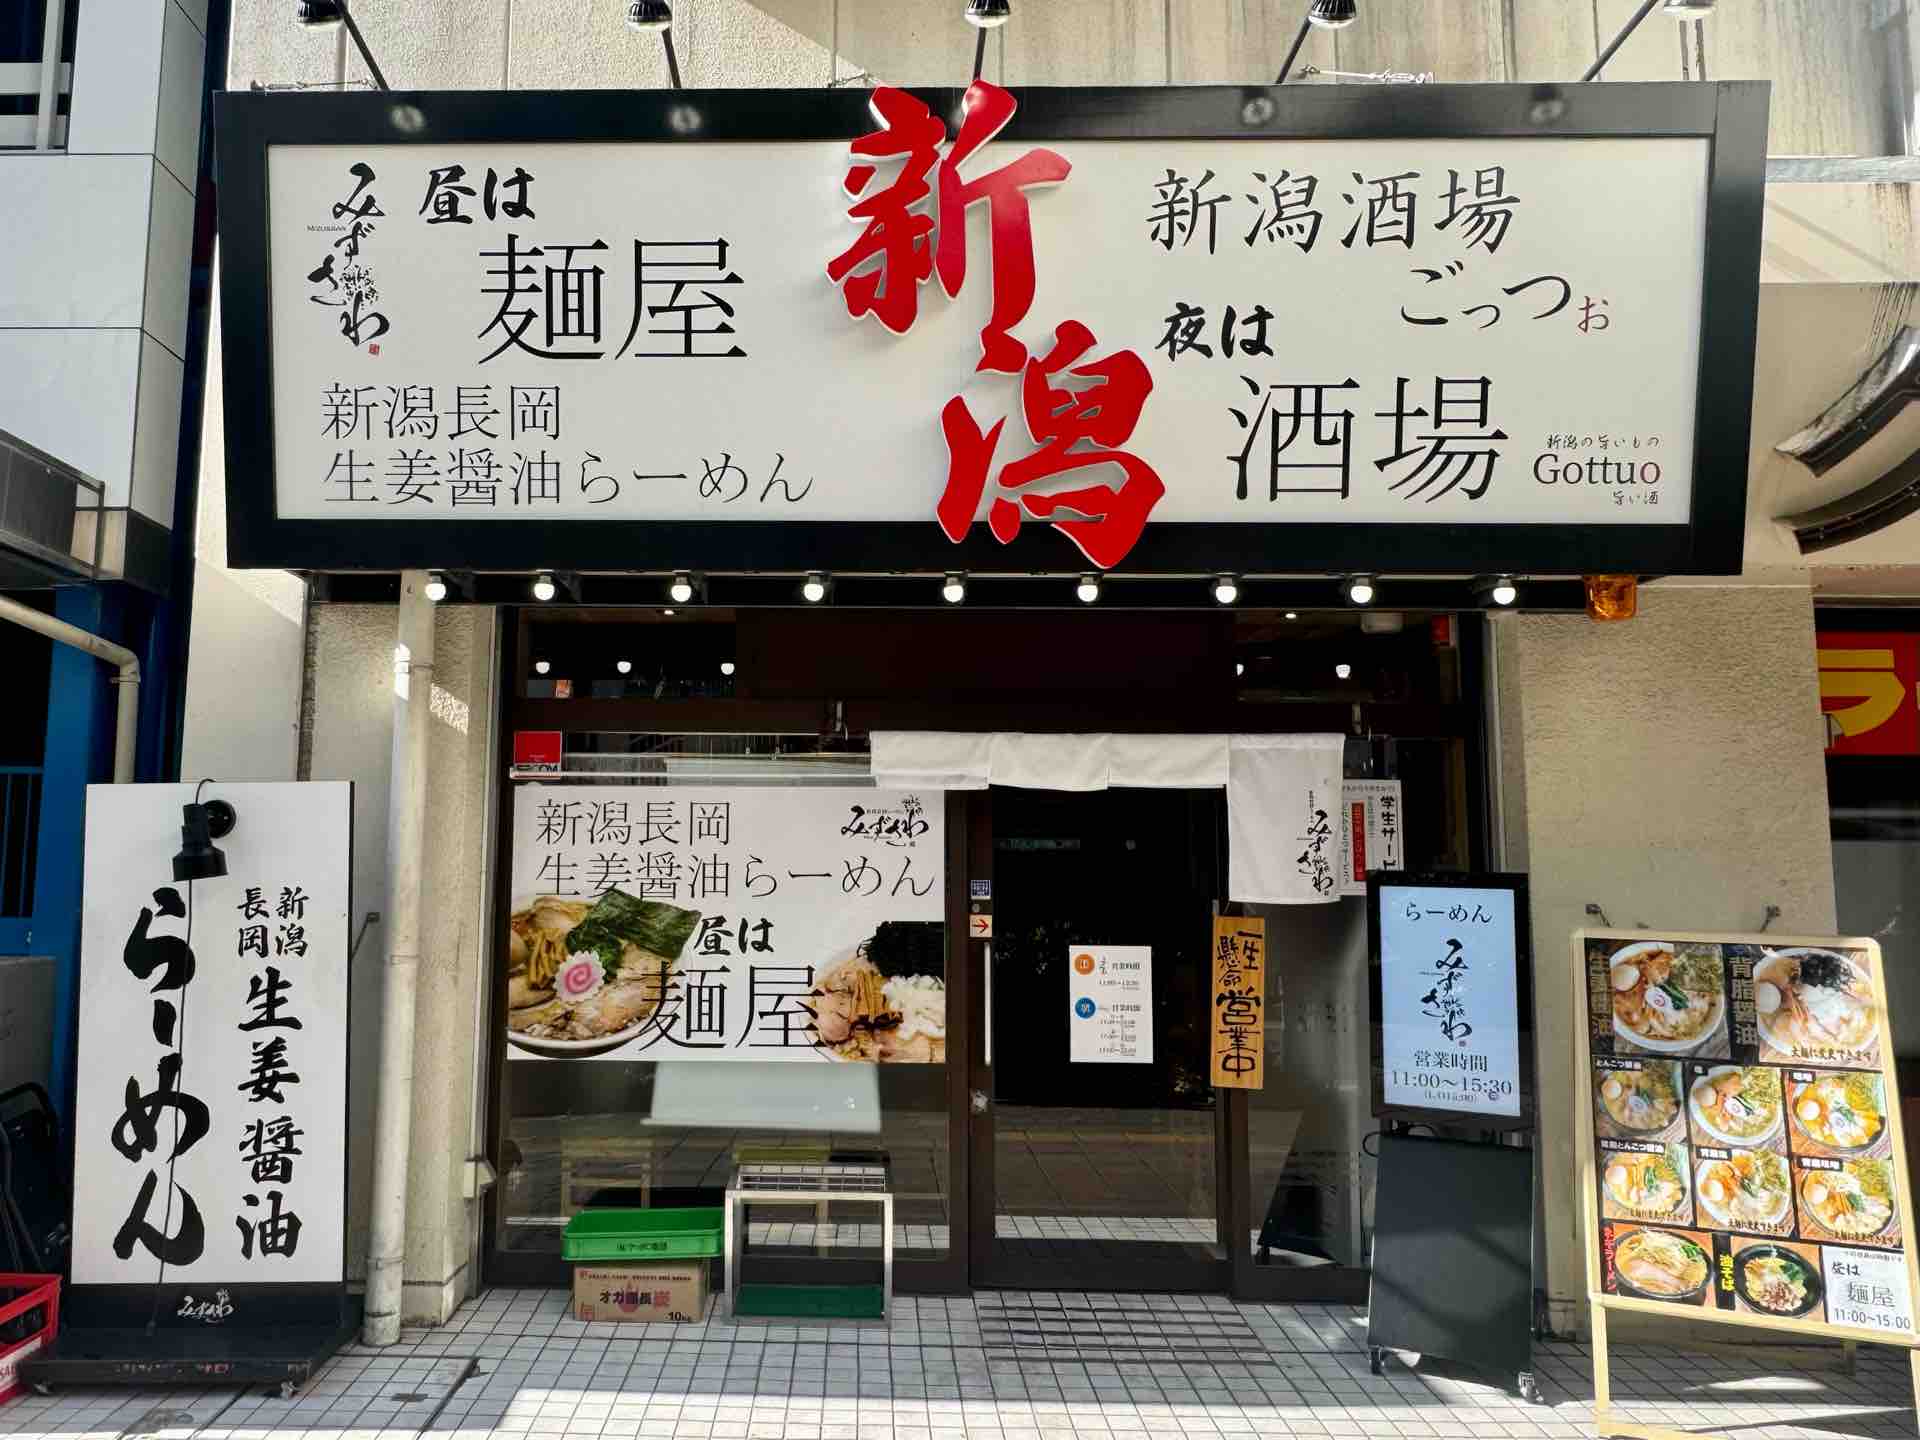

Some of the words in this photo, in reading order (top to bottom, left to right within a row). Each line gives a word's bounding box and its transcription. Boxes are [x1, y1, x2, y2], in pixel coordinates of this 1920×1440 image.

[419, 165, 536, 225] 昼は
[1146, 166, 1521, 255] 新潟酒場
[478, 233, 747, 364] 麺屋
[826, 79, 1166, 569] 新潟
[1155, 302, 1274, 361] 夜は
[321, 383, 560, 441] 新潟長岡
[1227, 376, 1508, 503] 酒場
[324, 448, 813, 507] 生姜醤油らーめん
[1533, 453, 1660, 484] Gottuo
[536, 799, 730, 846] 新潟長岡
[535, 851, 935, 900] 生姜醤油らーめん
[693, 915, 775, 956] 昼は
[1406, 902, 1493, 923] らーめん
[638, 960, 828, 1051] 麺屋
[111, 886, 210, 1267] らーめん
[1413, 1049, 1488, 1073] 営業時間
[236, 966, 305, 1261] 生姜醤油
